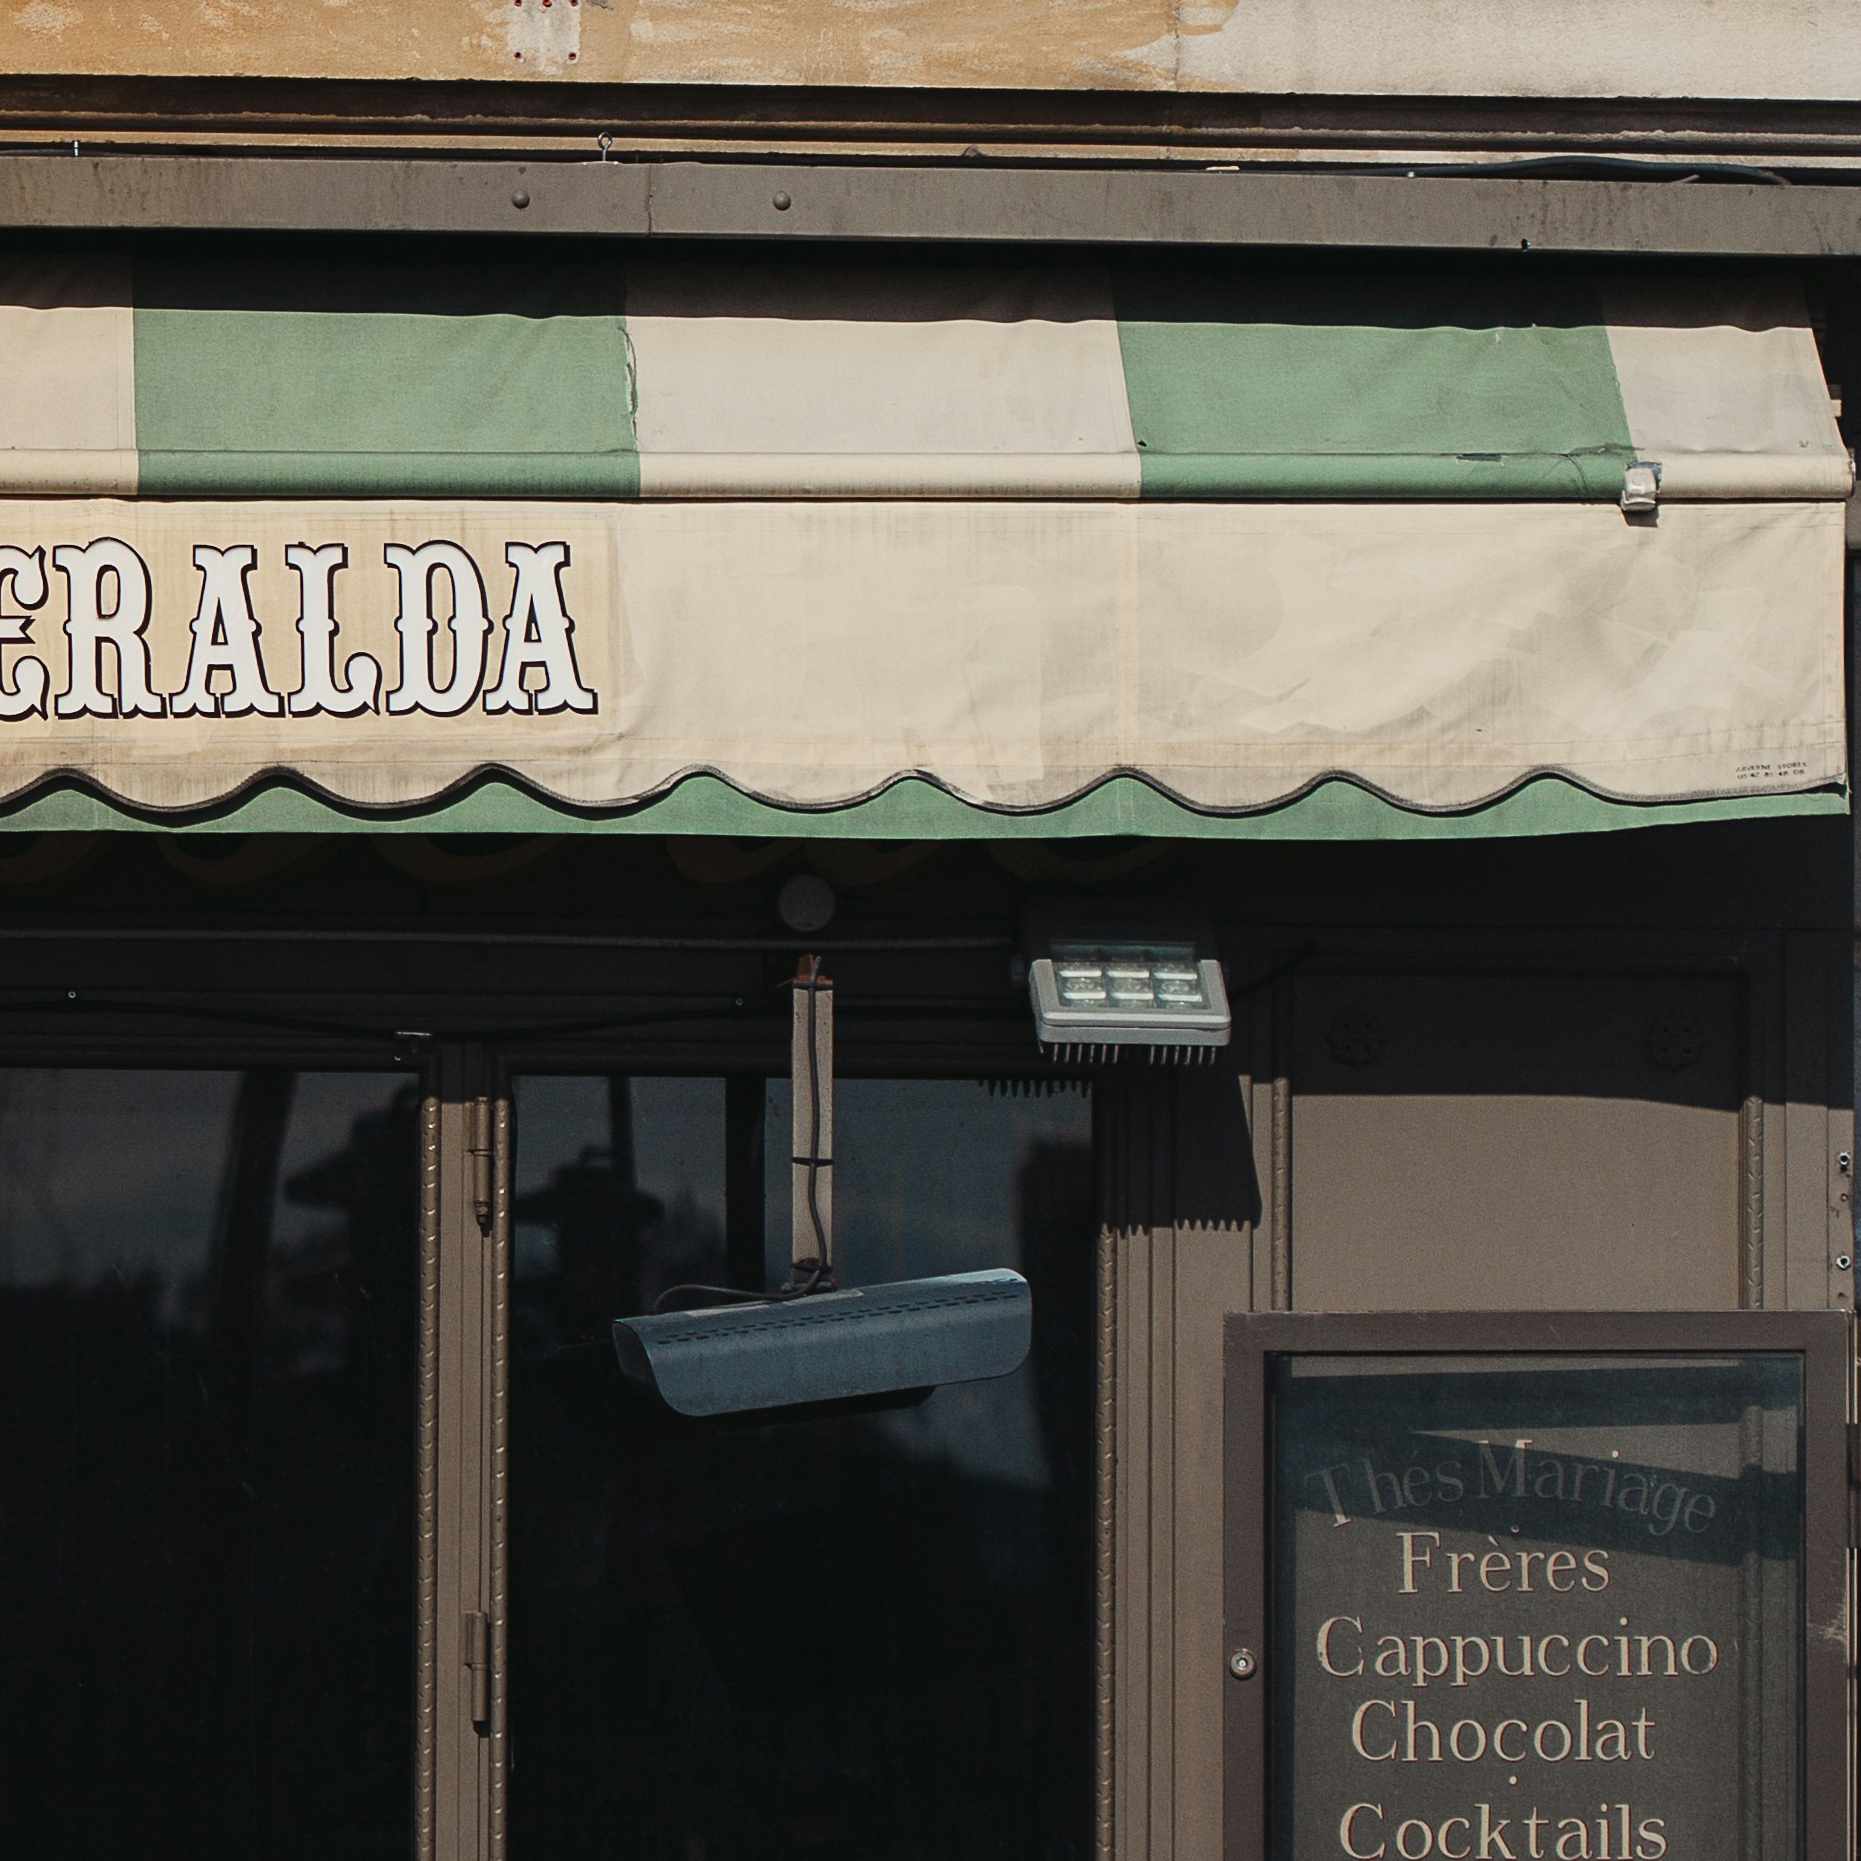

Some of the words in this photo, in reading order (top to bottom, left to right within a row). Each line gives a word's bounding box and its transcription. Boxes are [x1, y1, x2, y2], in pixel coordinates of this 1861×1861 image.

[1302, 1449, 1465, 1529] Thés
[1477, 1438, 1719, 1537] Mariage
[1396, 1531, 1612, 1595] Frères
[1316, 1615, 1720, 1688] Cappuccino
[1351, 1699, 1657, 1762] Chocolat
[1340, 1802, 1669, 1861] Cocktails
